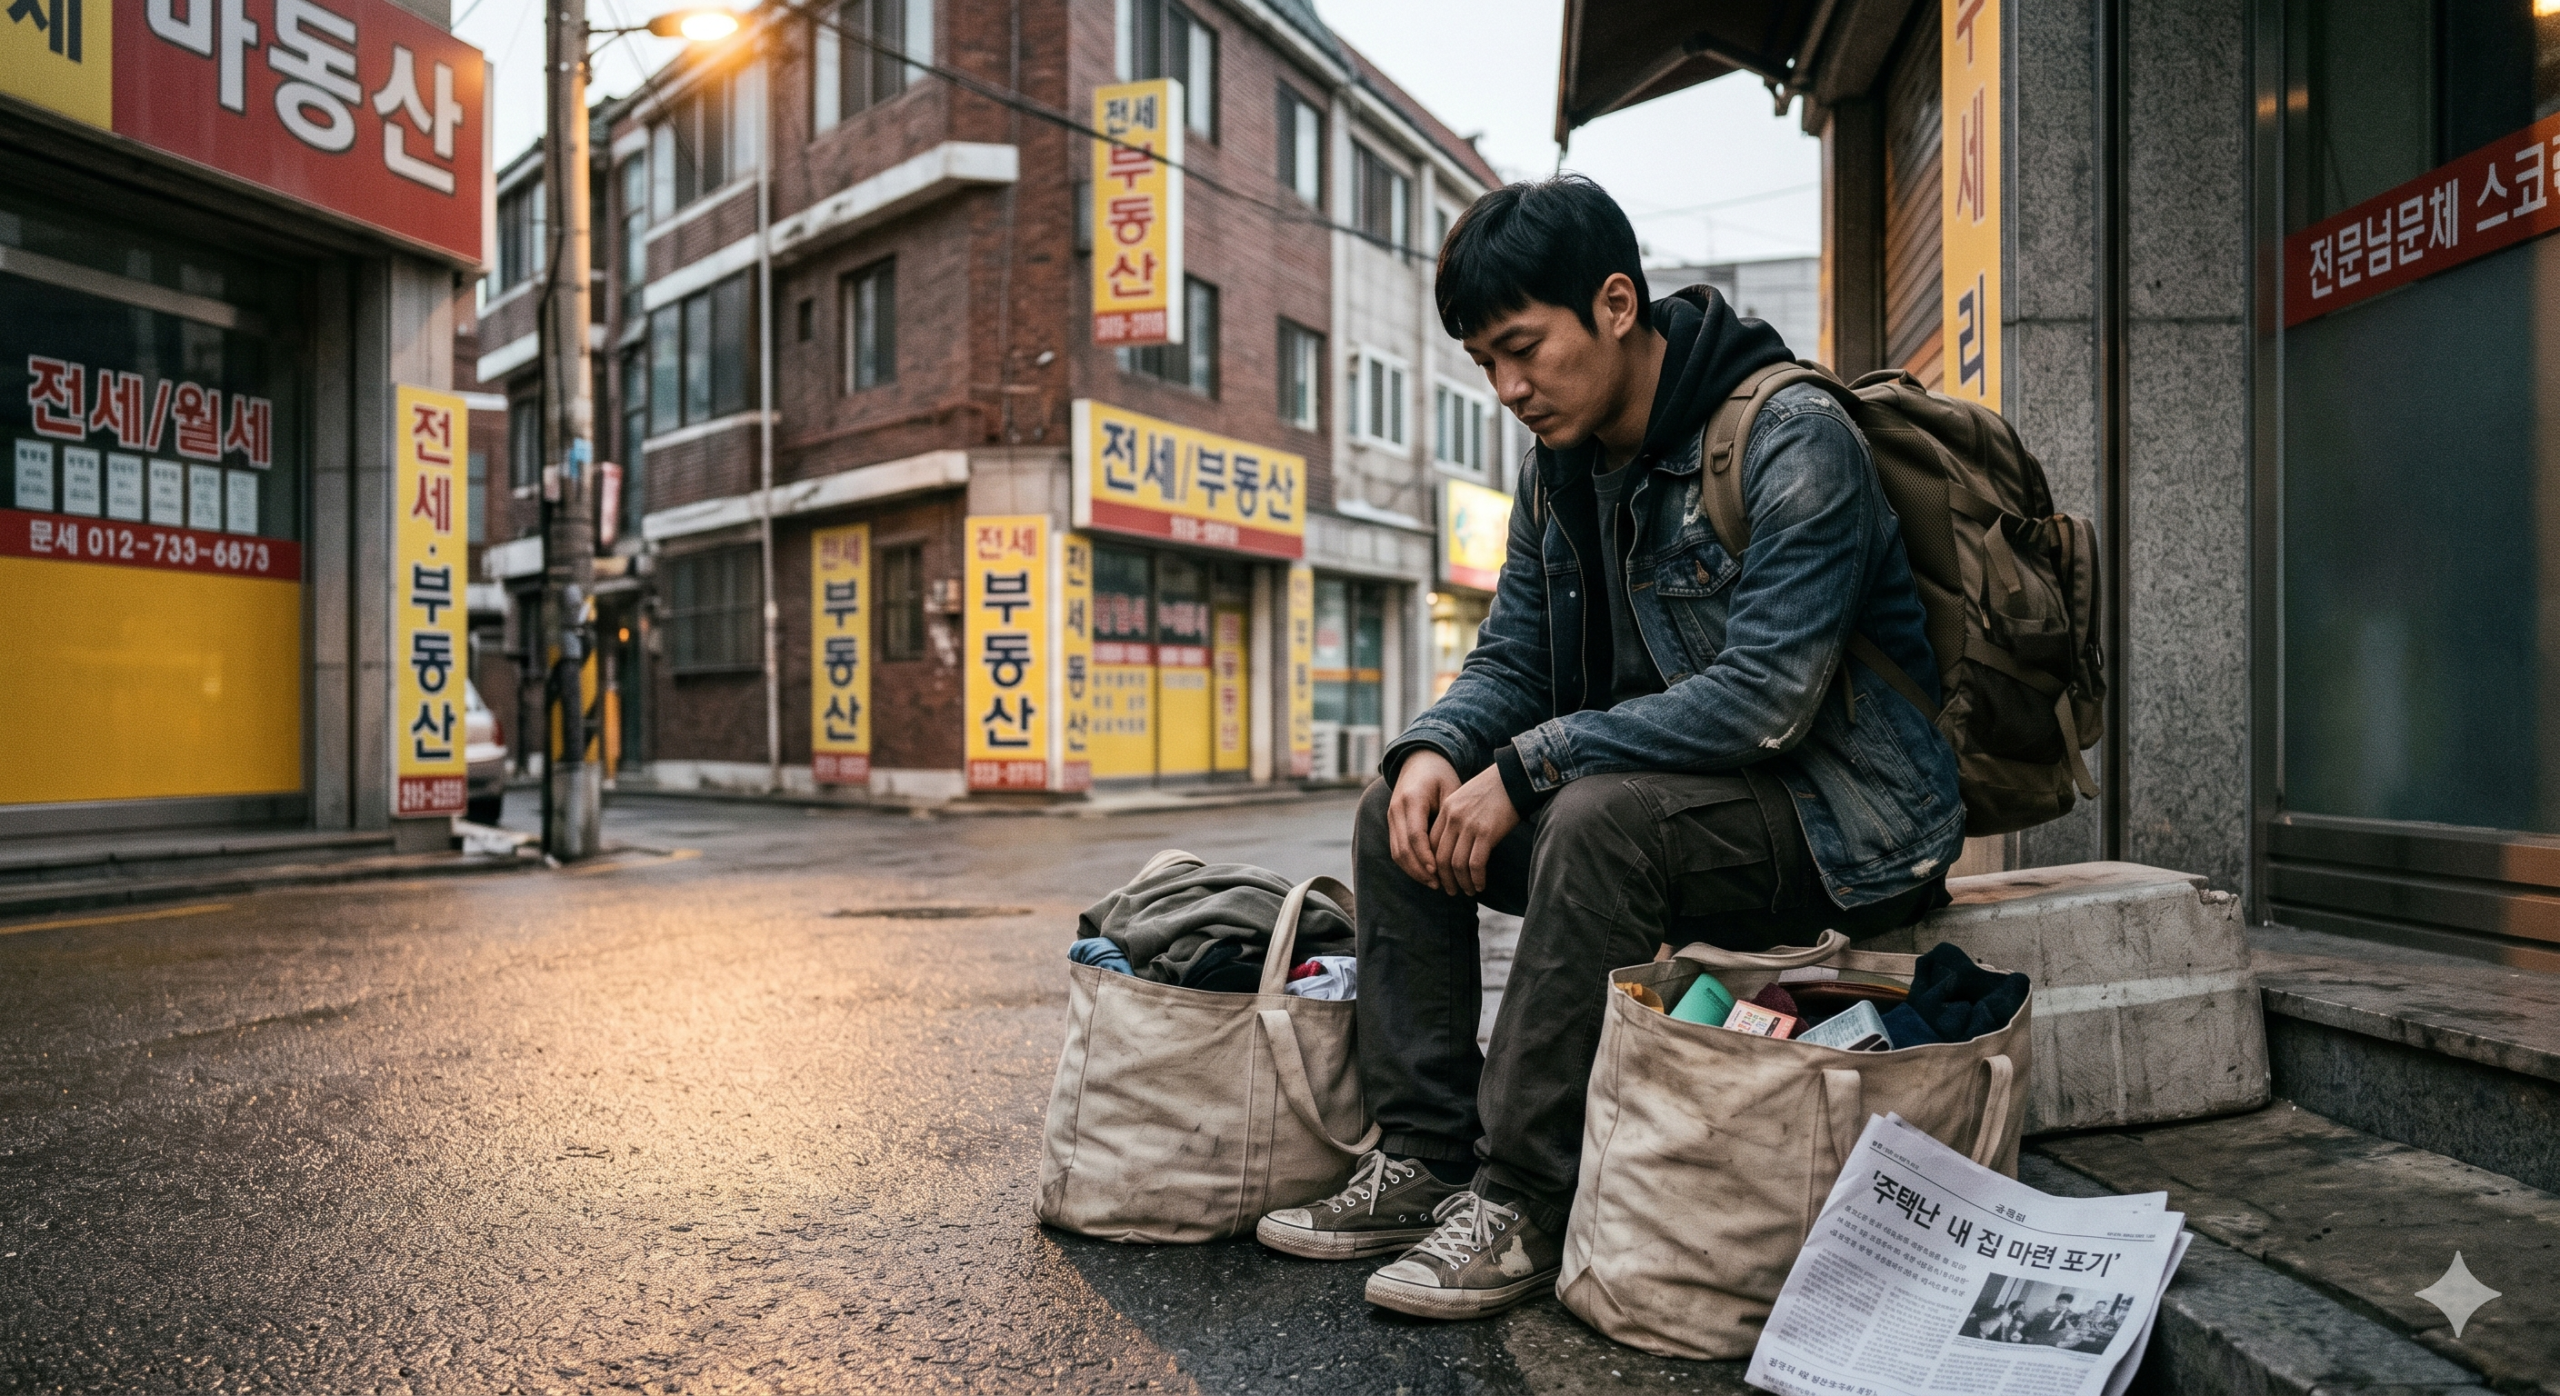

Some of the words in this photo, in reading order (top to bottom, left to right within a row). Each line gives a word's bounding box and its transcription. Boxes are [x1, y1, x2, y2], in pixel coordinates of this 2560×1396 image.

[1106, 96, 1157, 135] 전세
[1108, 141, 1157, 298] 부동산
[2309, 178, 2459, 300] 전문넘문체
[2476, 133, 2560, 233] 스코
[28, 354, 272, 470] 전세/월세
[1102, 421, 1295, 523] 전세/부동산
[976, 525, 1037, 561] 전세
[823, 579, 861, 742] 부동산
[983, 571, 1035, 747] 부동산
[1872, 1170, 1941, 1230] '주택난
[1947, 1215, 1973, 1249] 내
[1977, 1228, 2004, 1259] 집
[2006, 1239, 2058, 1270] 마련
[2059, 1248, 2122, 1278] 포기'
